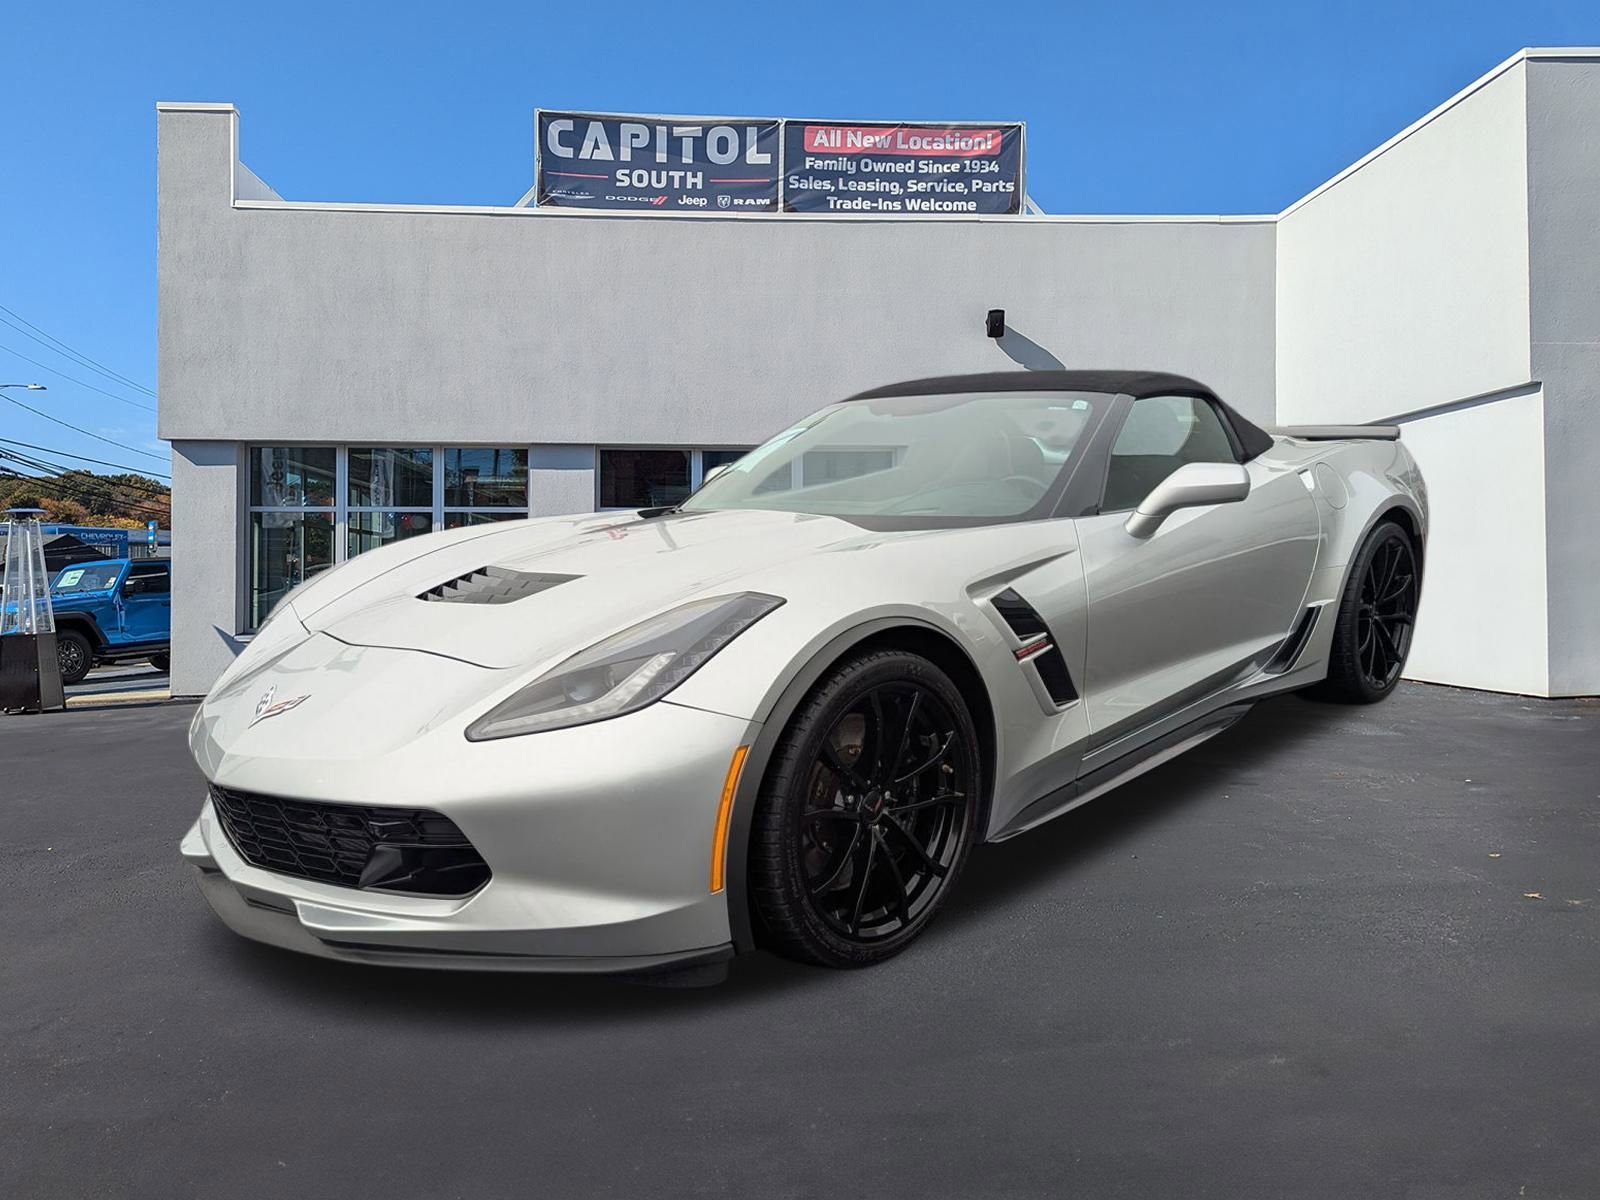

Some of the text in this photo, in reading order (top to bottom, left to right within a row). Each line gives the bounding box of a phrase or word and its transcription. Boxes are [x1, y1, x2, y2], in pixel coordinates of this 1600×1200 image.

[547, 119, 771, 165] CAPITOL
[813, 129, 993, 150] All New Location!
[805, 157, 999, 174] Family Owned Since 1934
[615, 168, 703, 189] SOUTH
[788, 176, 1015, 195] Sales, Leasing, Service, Parts
[678, 195, 708, 207] Jeep
[826, 196, 977, 212] Trade-Ins Welcome
